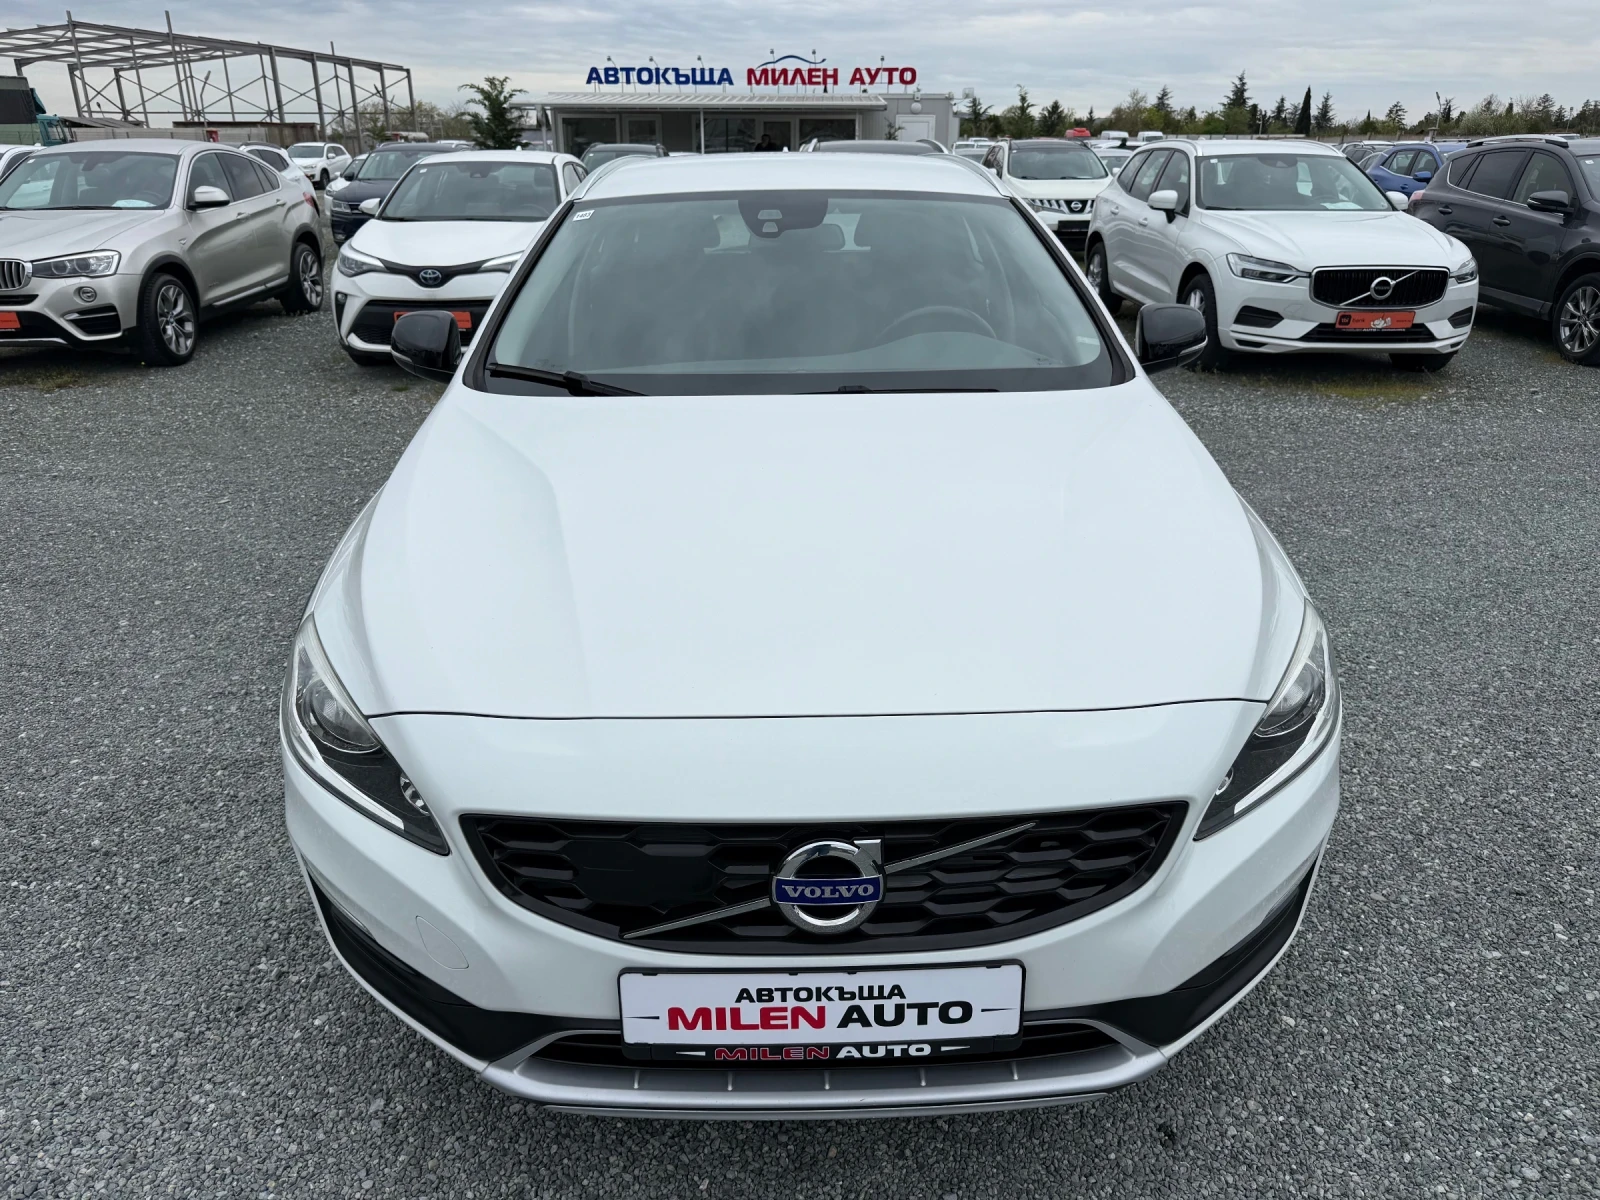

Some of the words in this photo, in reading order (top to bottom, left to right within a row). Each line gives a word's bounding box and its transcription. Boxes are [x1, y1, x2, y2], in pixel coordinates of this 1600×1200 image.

[586, 67, 734, 85] АВТОКЪЩА
[747, 68, 838, 85] МИЛЕН
[849, 67, 917, 85] АУТО
[782, 884, 874, 898] VOLVO
[735, 984, 907, 1003] АВТОКЪЩА
[667, 1006, 826, 1031] MILEN
[836, 1000, 973, 1029] AUTO
[714, 1046, 830, 1061] MILEN
[836, 1043, 932, 1059] AUTO
